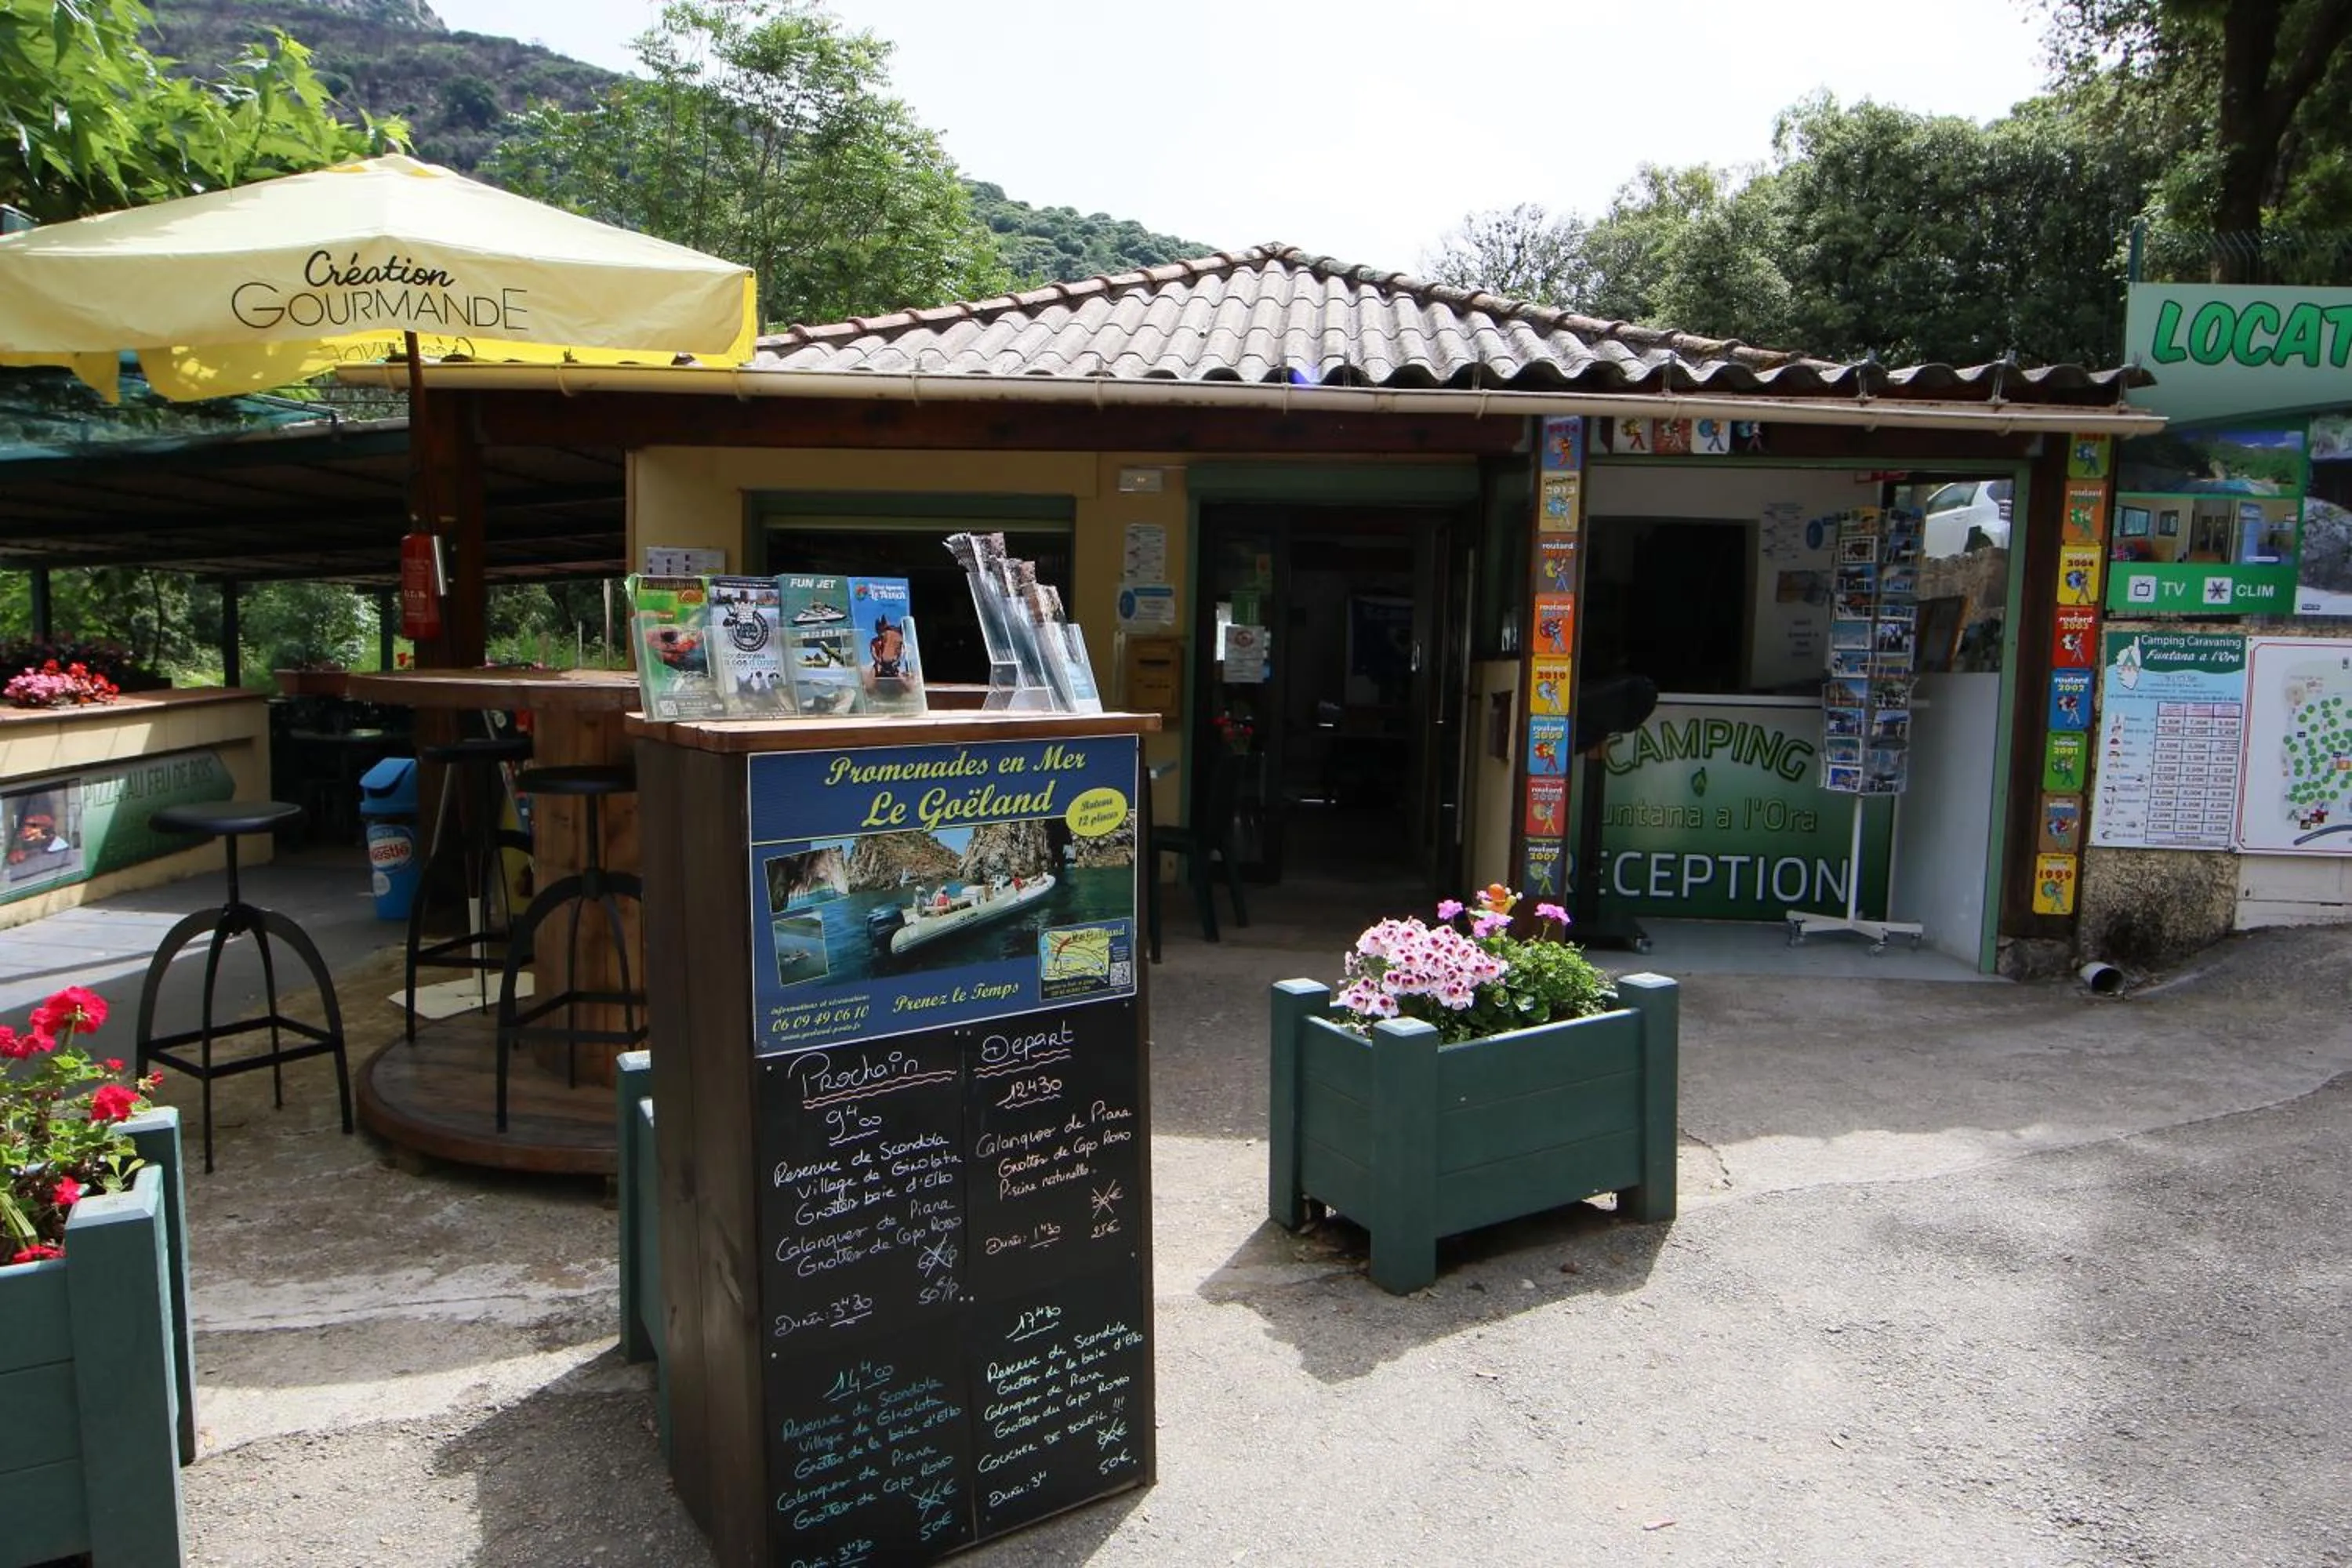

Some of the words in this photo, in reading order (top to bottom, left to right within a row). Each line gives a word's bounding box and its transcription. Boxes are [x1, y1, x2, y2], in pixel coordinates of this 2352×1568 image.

[304, 250, 456, 288] Création
[230, 281, 528, 331] GOURMANDE
[2152, 299, 2352, 367] LOCAT
[789, 578, 815, 589] FUN
[816, 579, 837, 589] JET
[2162, 582, 2186, 597] TV
[2235, 584, 2274, 597] CLIM
[2141, 634, 2185, 648] Camping
[2187, 636, 2241, 649] Caravaning
[2146, 649, 2195, 662] Funtana
[1536, 671, 1566, 680] 2010
[825, 750, 988, 786] Promenades
[999, 757, 1026, 775] en
[1033, 745, 1086, 771] Mer
[1604, 718, 1814, 782] CAMPING
[862, 791, 908, 827] Le
[918, 779, 1056, 831] Goëland
[1601, 800, 1703, 828] untana
[1715, 806, 1731, 829] a
[1744, 798, 1817, 833] l'Ora
[1568, 850, 1849, 903] CEPTION
[892, 995, 947, 1014] Prenez
[953, 988, 967, 1004] le
[971, 981, 1019, 1004] Temps
[772, 1018, 789, 1033] 06
[793, 1014, 811, 1029] 09
[814, 1011, 831, 1025] 49
[834, 1007, 851, 1022] 06
[854, 1004, 870, 1019] 10
[788, 1051, 919, 1098] Prochain
[1064, 1114, 1085, 1133] de
[1091, 1100, 1132, 1123] Piana
[851, 1149, 872, 1167] de
[880, 1134, 949, 1160] Scandola
[1053, 1145, 1070, 1162] de
[864, 1171, 880, 1183] de
[877, 1217, 897, 1230] de
[910, 1198, 956, 1219] Piana
[869, 1239, 891, 1254] de
[1048, 1344, 1067, 1360] de
